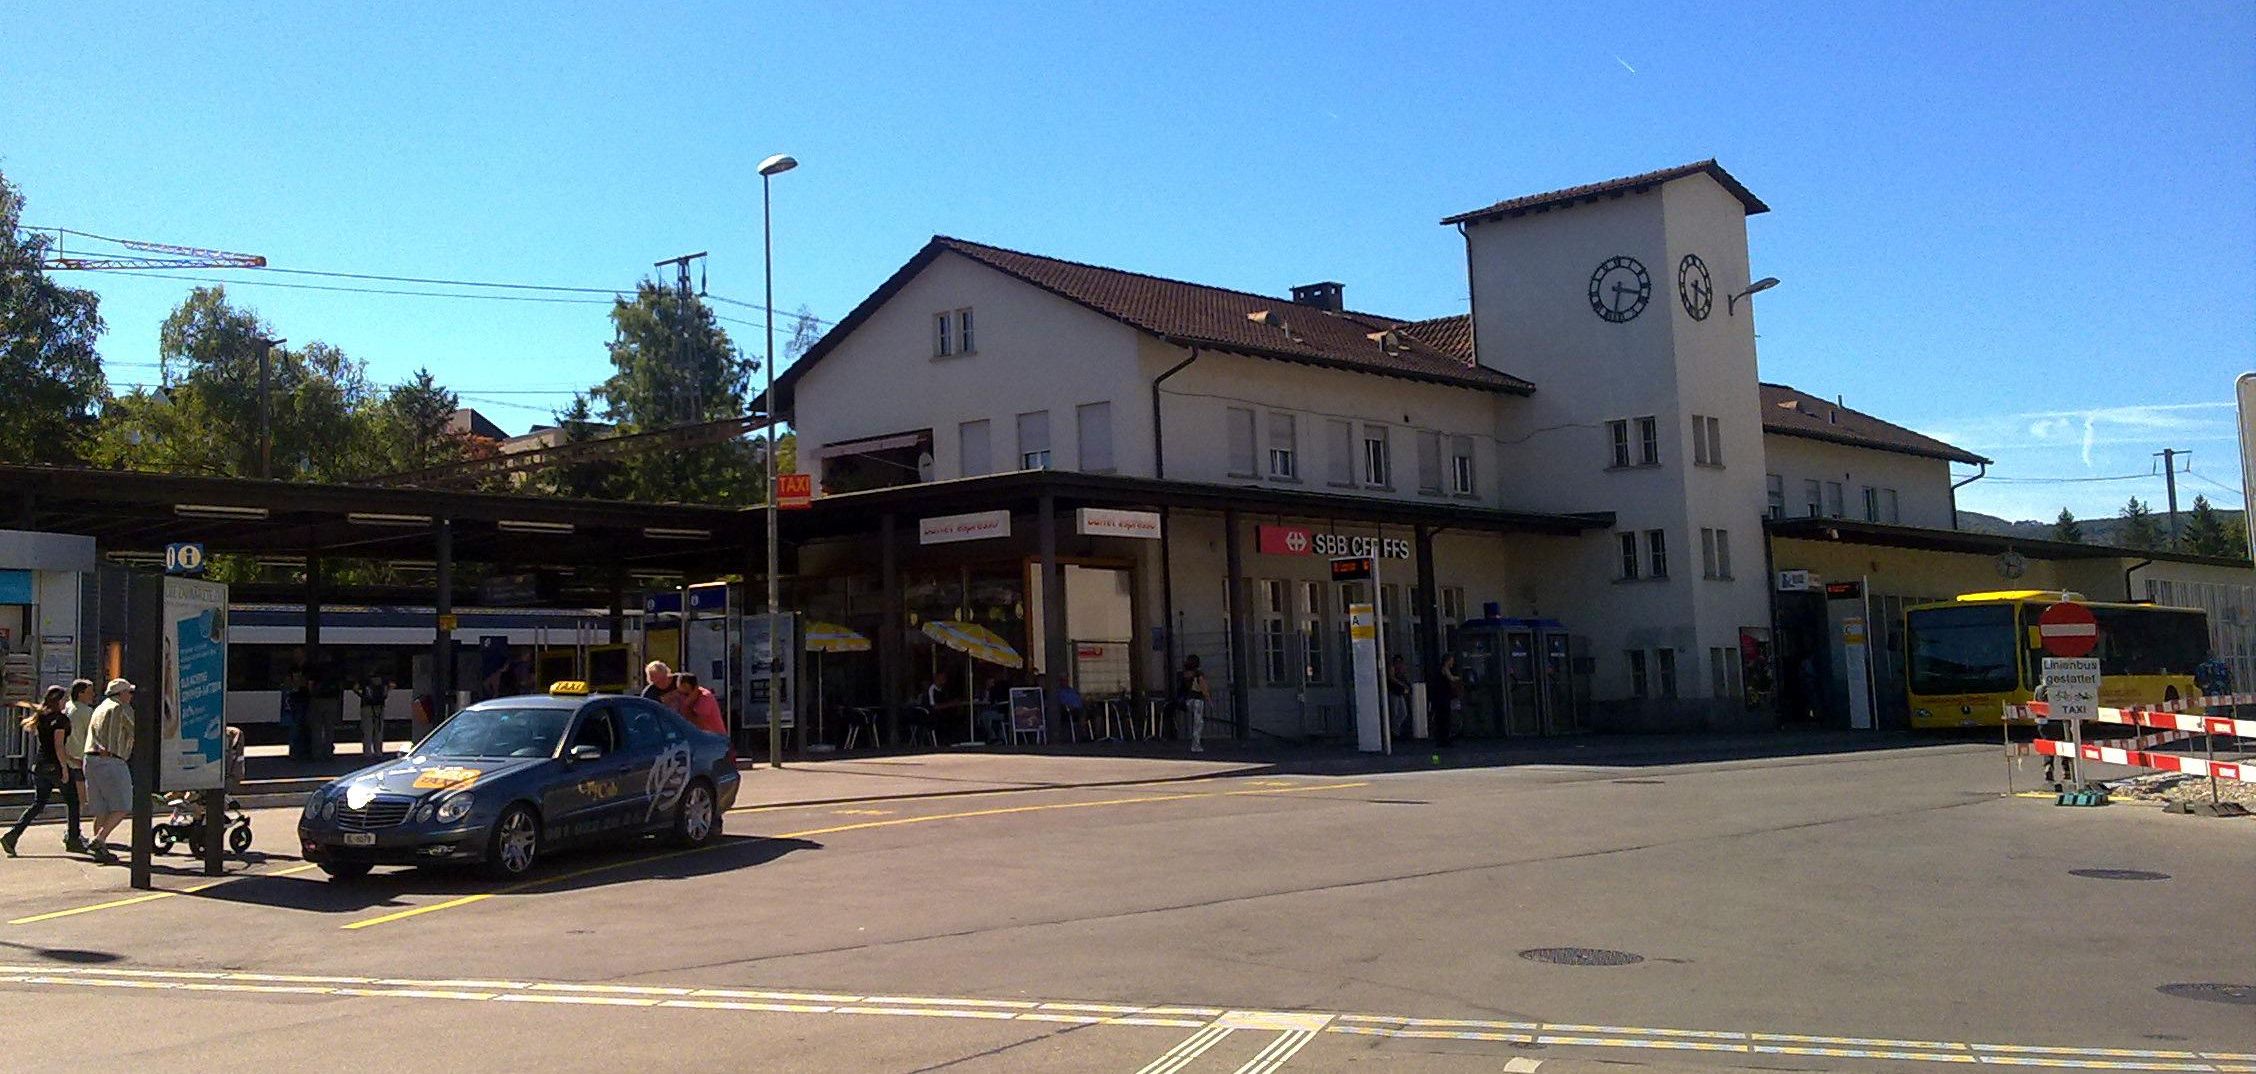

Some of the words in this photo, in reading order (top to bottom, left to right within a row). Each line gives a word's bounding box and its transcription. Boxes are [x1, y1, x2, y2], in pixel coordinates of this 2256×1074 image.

[779, 476, 809, 492] TAXI
[1315, 533, 1348, 554] SBB
[1383, 537, 1410, 560] FFS
[1352, 616, 1360, 626] A
[2044, 660, 2098, 670] Linienbus
[2046, 674, 2097, 686] gestattet
[556, 682, 582, 691] TAXI
[2062, 705, 2088, 714] TAXI
